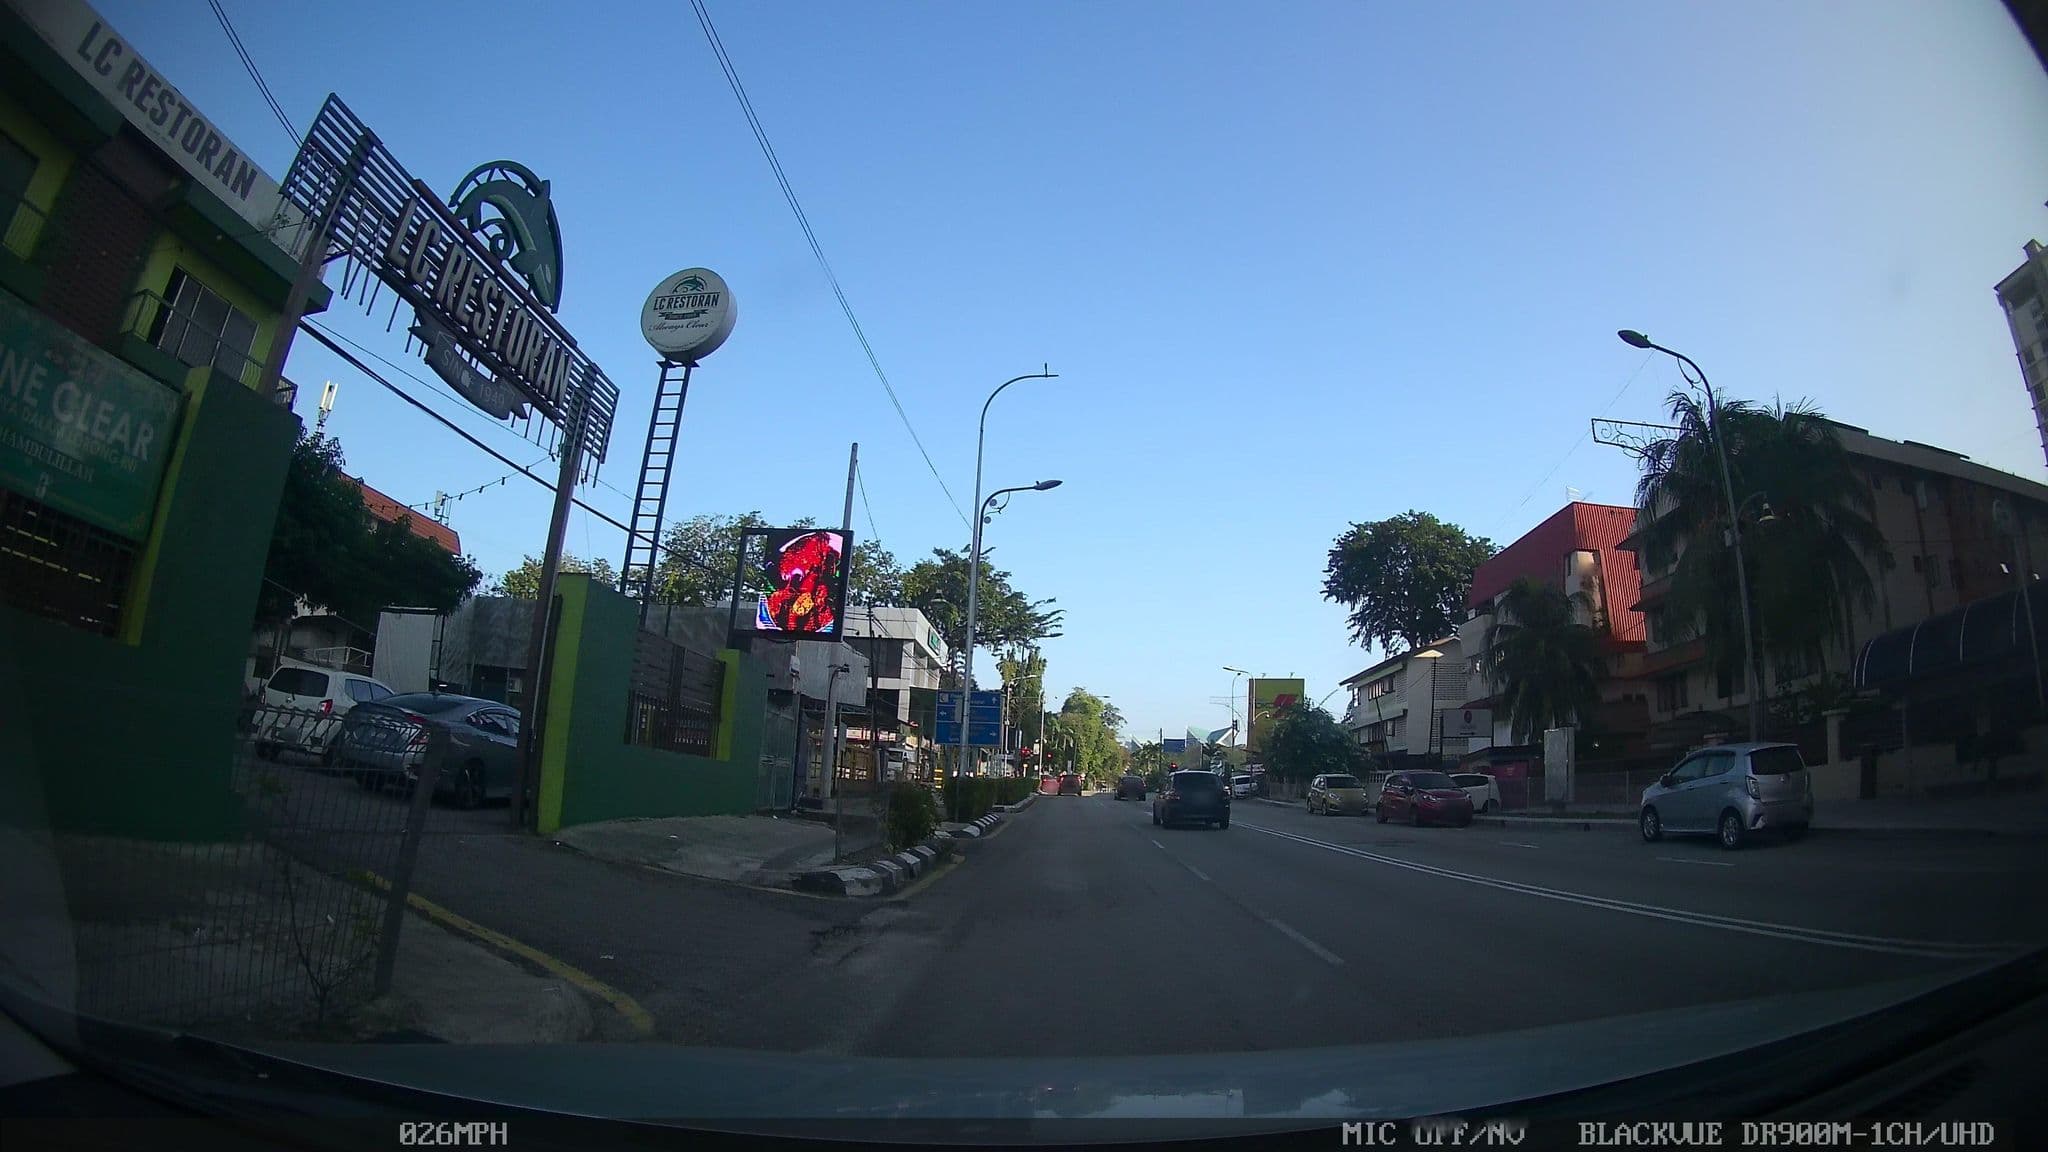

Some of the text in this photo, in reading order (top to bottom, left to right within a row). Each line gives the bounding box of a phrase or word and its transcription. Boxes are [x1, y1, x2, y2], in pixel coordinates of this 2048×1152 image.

[77, 22, 258, 200] LC RESTORAN
[386, 196, 573, 404] LC RESTORAN
[653, 293, 720, 311] LC RESTORAN
[0, 344, 154, 463] NE CLEAR
